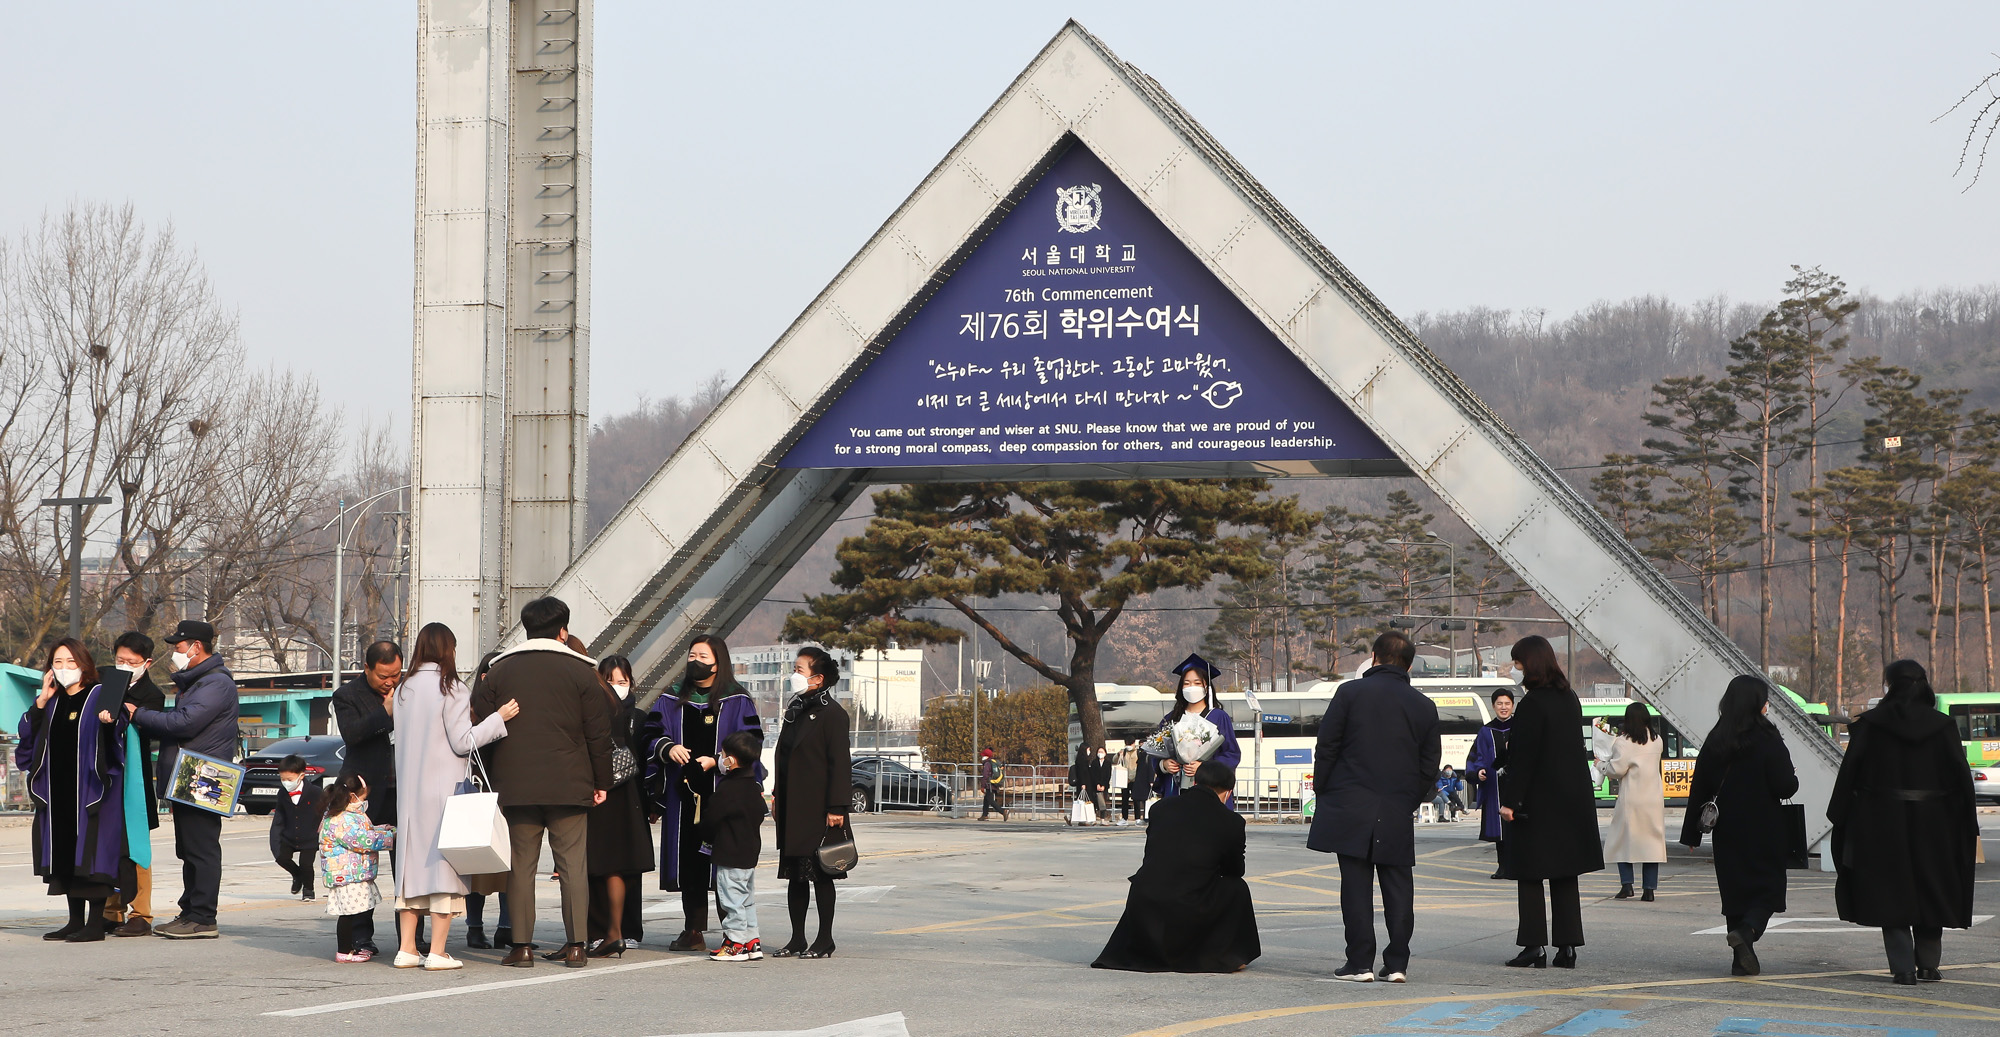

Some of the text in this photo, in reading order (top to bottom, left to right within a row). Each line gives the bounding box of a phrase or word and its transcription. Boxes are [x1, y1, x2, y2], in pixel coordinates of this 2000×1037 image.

[1048, 267, 1088, 276] NATIONAL
[1090, 266, 1136, 274] UNIVERSITY
[1004, 286, 1153, 302] 76th Commencement
[959, 304, 1199, 342] 제76회 학위수여식
[1000, 361, 1026, 380] 우리
[1033, 356, 1104, 384] 졸업한다.
[1112, 356, 1155, 378] 그동안
[1162, 353, 1231, 378] 고마웠어.
[918, 394, 948, 410] 이제
[956, 395, 972, 406] 더
[979, 391, 990, 412] 큰
[996, 391, 1067, 410] 세상에서
[1075, 390, 1108, 405] 다시
[1116, 390, 1170, 408] 만나자
[850, 419, 1315, 438] You came out stronger and wiser at SNU. Please know that we are proud of you
[834, 436, 1336, 456] for a strong moral compass, deep compassion for others, and courageous leadership.
[1983, 742, 2000, 752] 공무
[1664, 761, 1687, 770] 공무원
